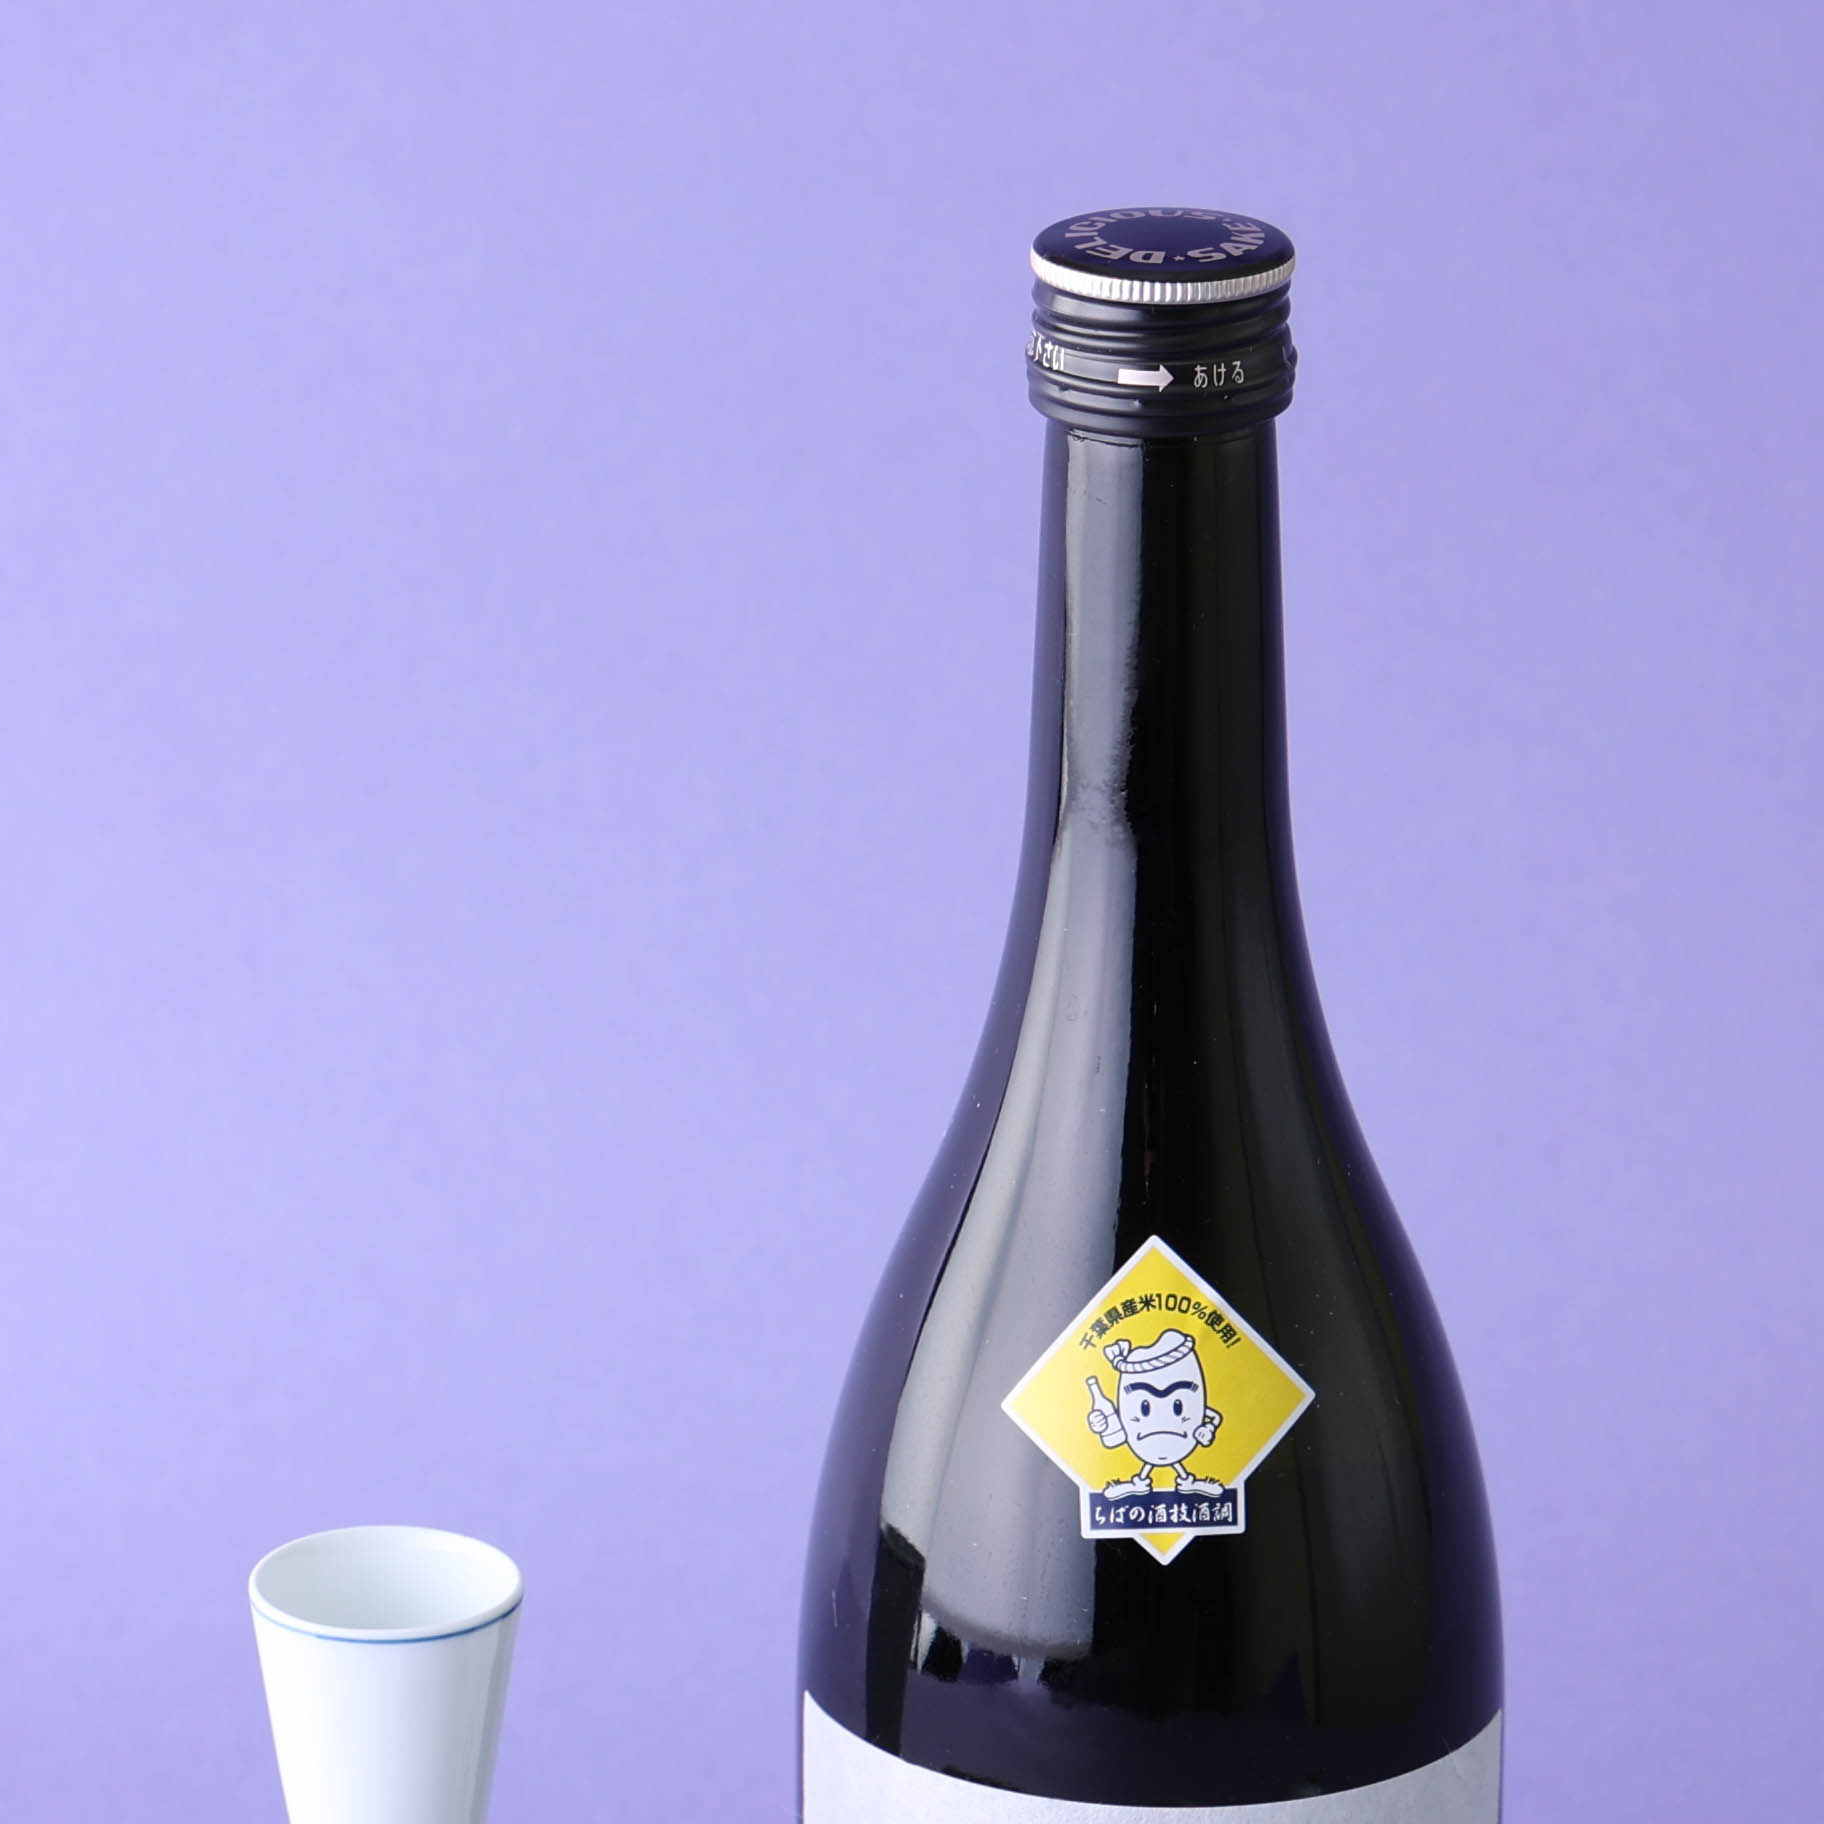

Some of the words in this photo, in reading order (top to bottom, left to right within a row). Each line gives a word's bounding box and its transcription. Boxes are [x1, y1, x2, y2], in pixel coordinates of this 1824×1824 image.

[1064, 208, 1226, 265] DELICIOUS
[1187, 222, 1266, 263] SAKE
[1193, 360, 1245, 389] あける
